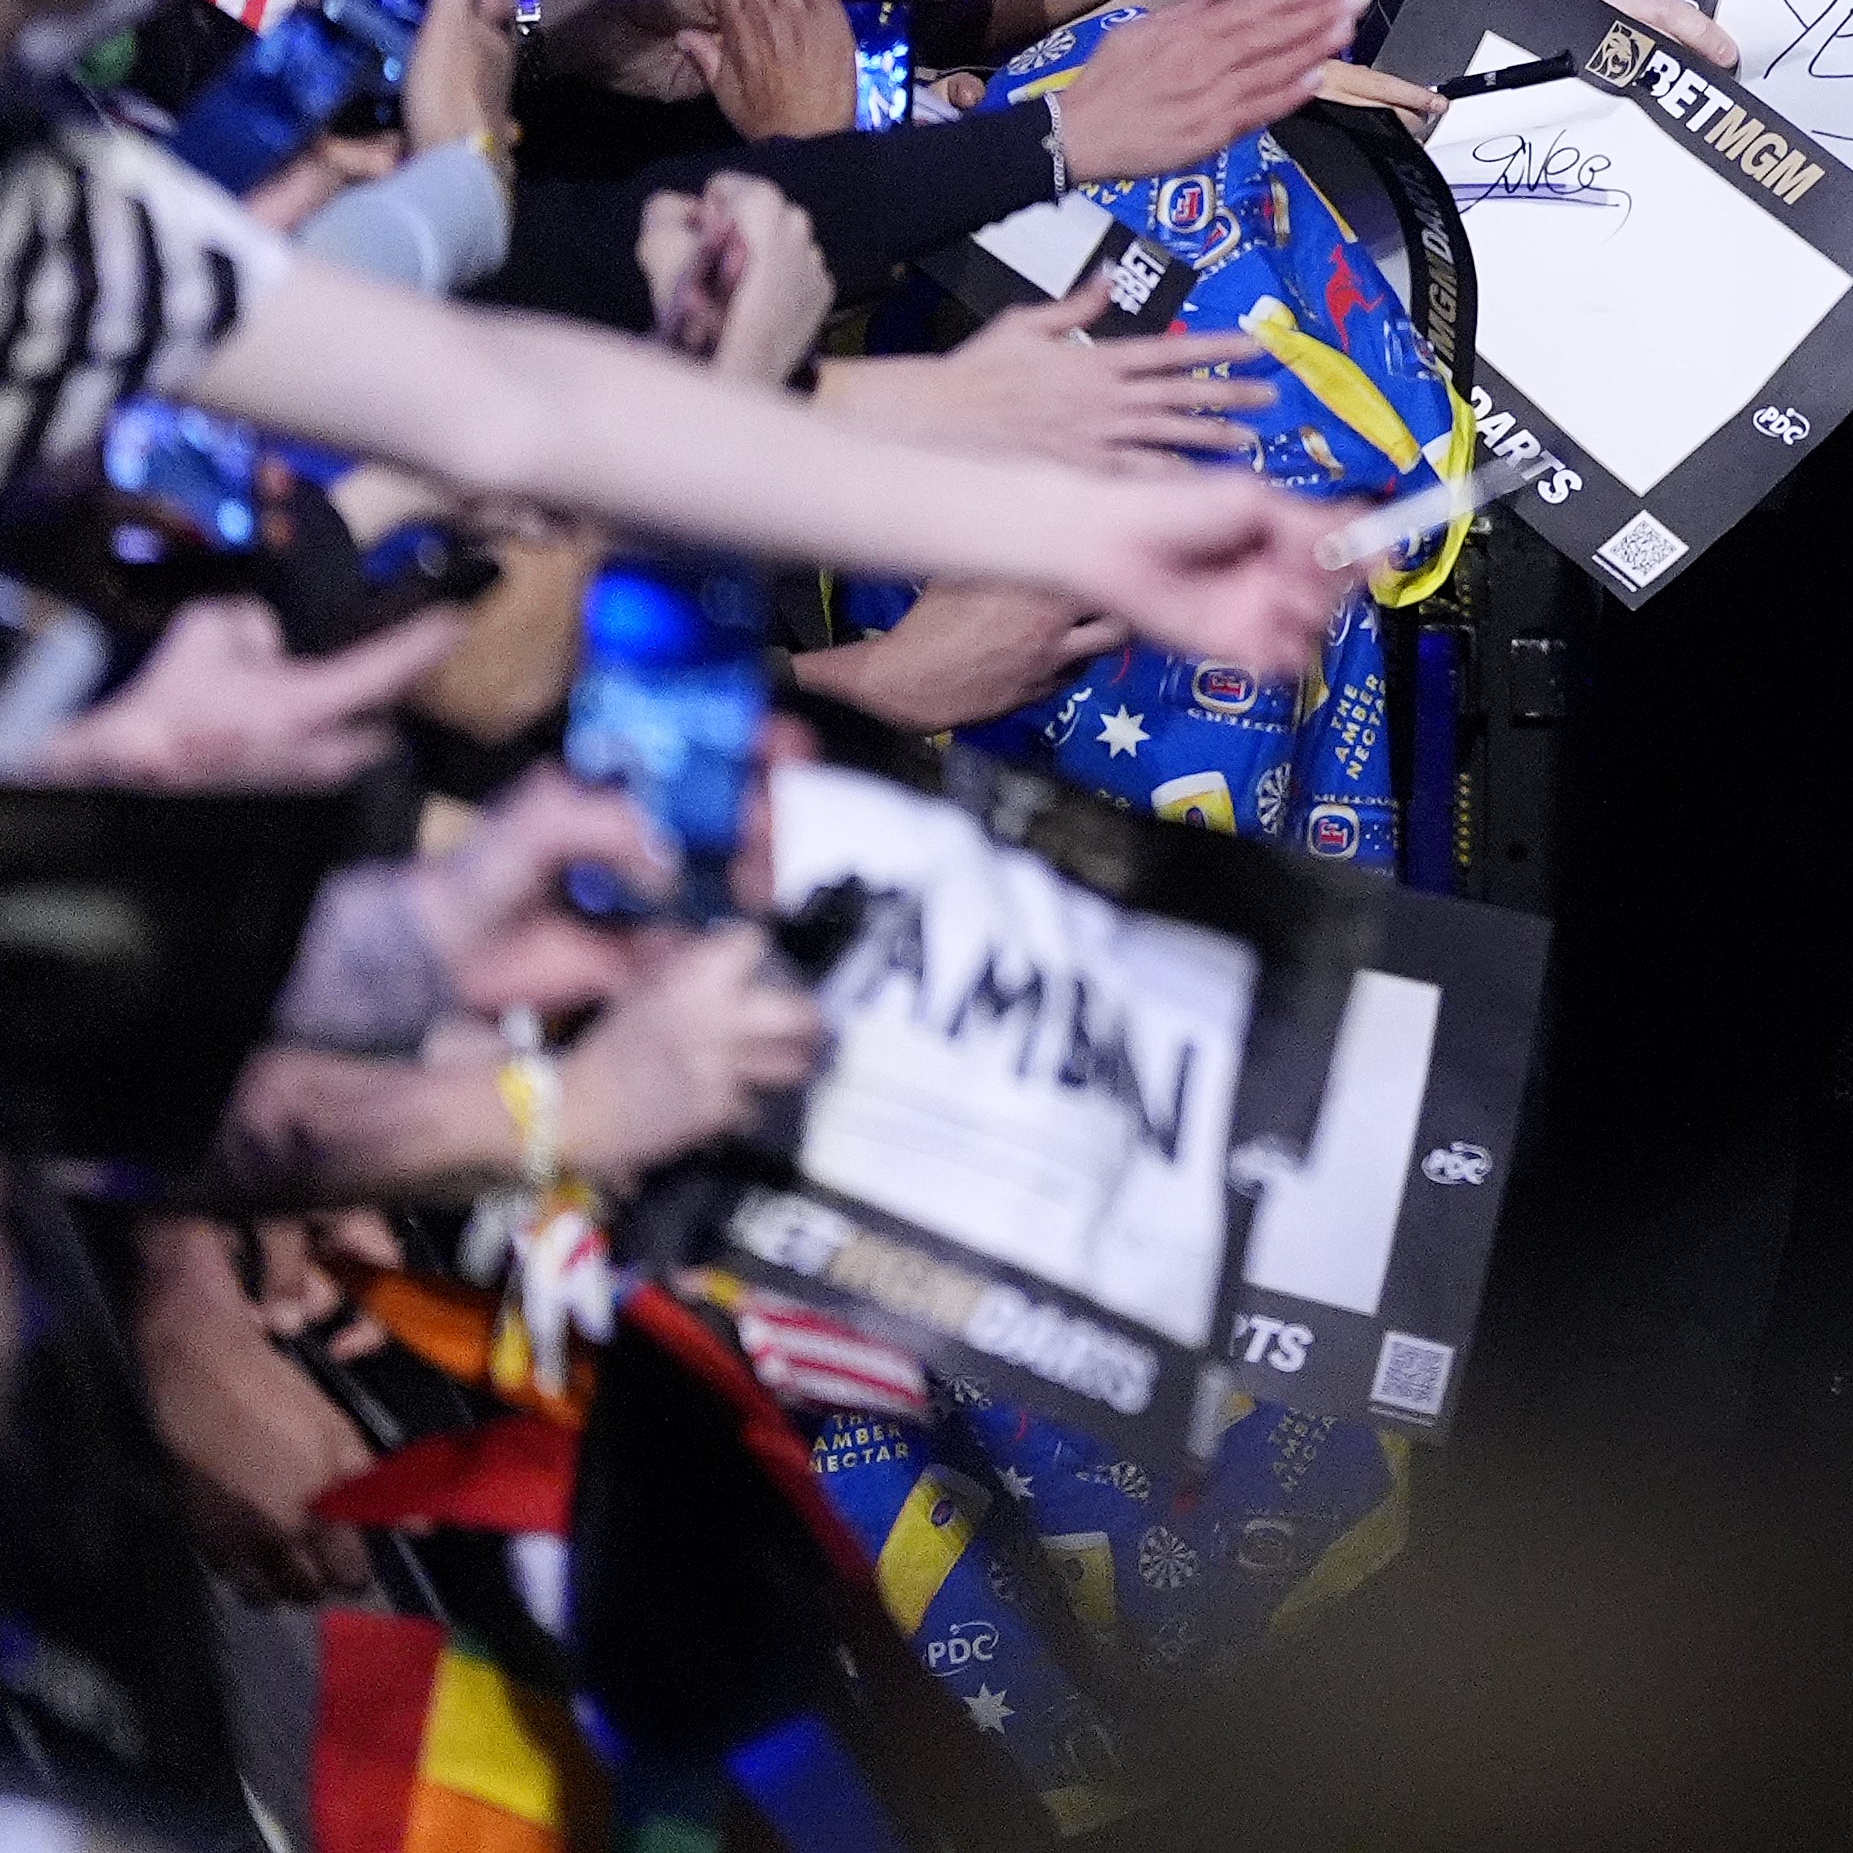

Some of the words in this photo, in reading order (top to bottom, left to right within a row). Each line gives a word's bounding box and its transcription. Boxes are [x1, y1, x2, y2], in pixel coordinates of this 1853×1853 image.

[1643, 47, 1826, 206] BETMGM
[1751, 405, 1811, 446] PDC
[925, 1629, 997, 1671] PDC
